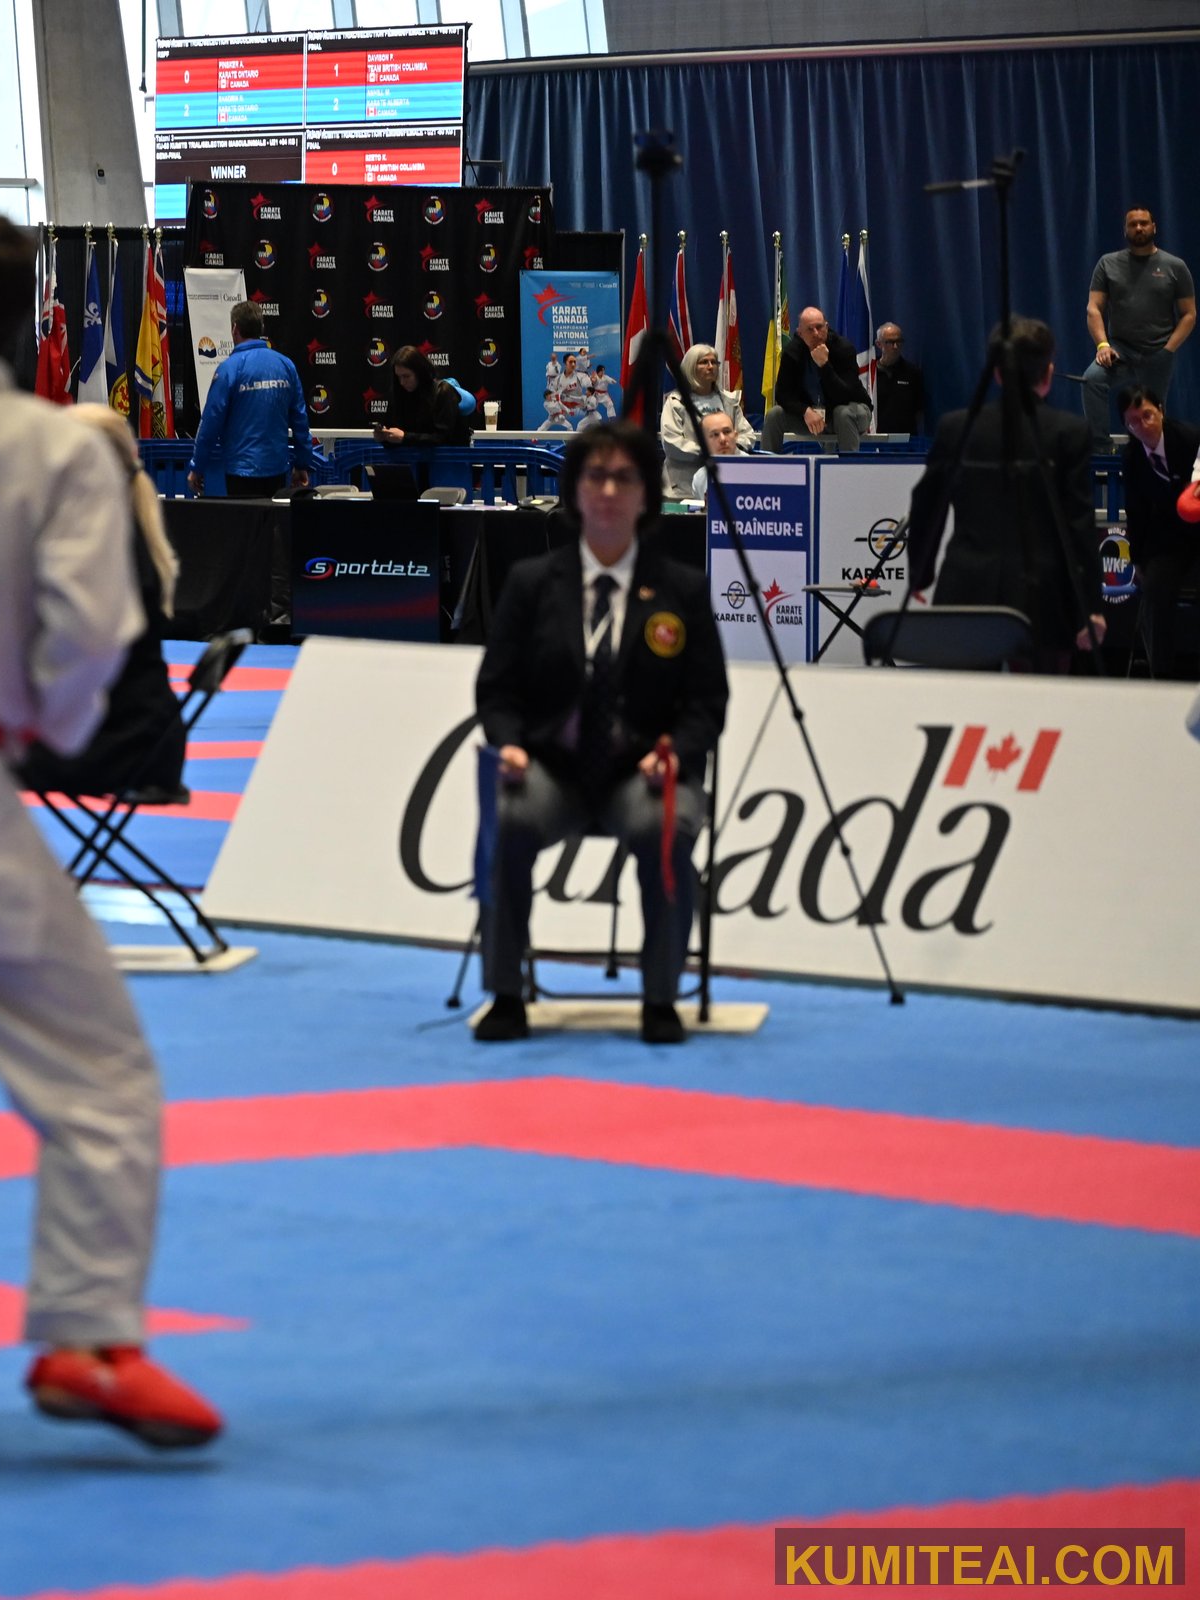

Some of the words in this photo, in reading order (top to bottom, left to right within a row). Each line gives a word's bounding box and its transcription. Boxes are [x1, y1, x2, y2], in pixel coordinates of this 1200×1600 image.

[333, 63, 339, 77] 1
[367, 64, 381, 72] TEAM
[184, 70, 190, 84] 0
[218, 70, 238, 79] KARATE
[379, 73, 400, 82] CANADA
[230, 80, 250, 88] CANADA
[333, 97, 339, 111] 2
[184, 104, 190, 117] 2
[210, 165, 247, 179] WINNER
[332, 162, 338, 176] 0
[365, 164, 379, 172] TEAM
[377, 174, 397, 182] CANADA
[260, 206, 281, 214] KARATE
[373, 209, 394, 217] KARATE
[552, 306, 588, 315] KARATE
[552, 315, 588, 324] CANADA
[553, 331, 589, 339] NATIONAL
[239, 379, 290, 392] ALBERTA
[735, 496, 781, 511] COACH
[711, 517, 803, 537] ENRAÎNEUR·E
[1107, 527, 1127, 536] WORLD
[1102, 557, 1128, 574] WKF
[842, 567, 905, 580] KARATE
[776, 605, 802, 615] KARATE
[714, 613, 744, 622] KARATE
[746, 614, 757, 623] BC
[776, 615, 803, 625] CANADA
[398, 711, 1013, 936] Cada
